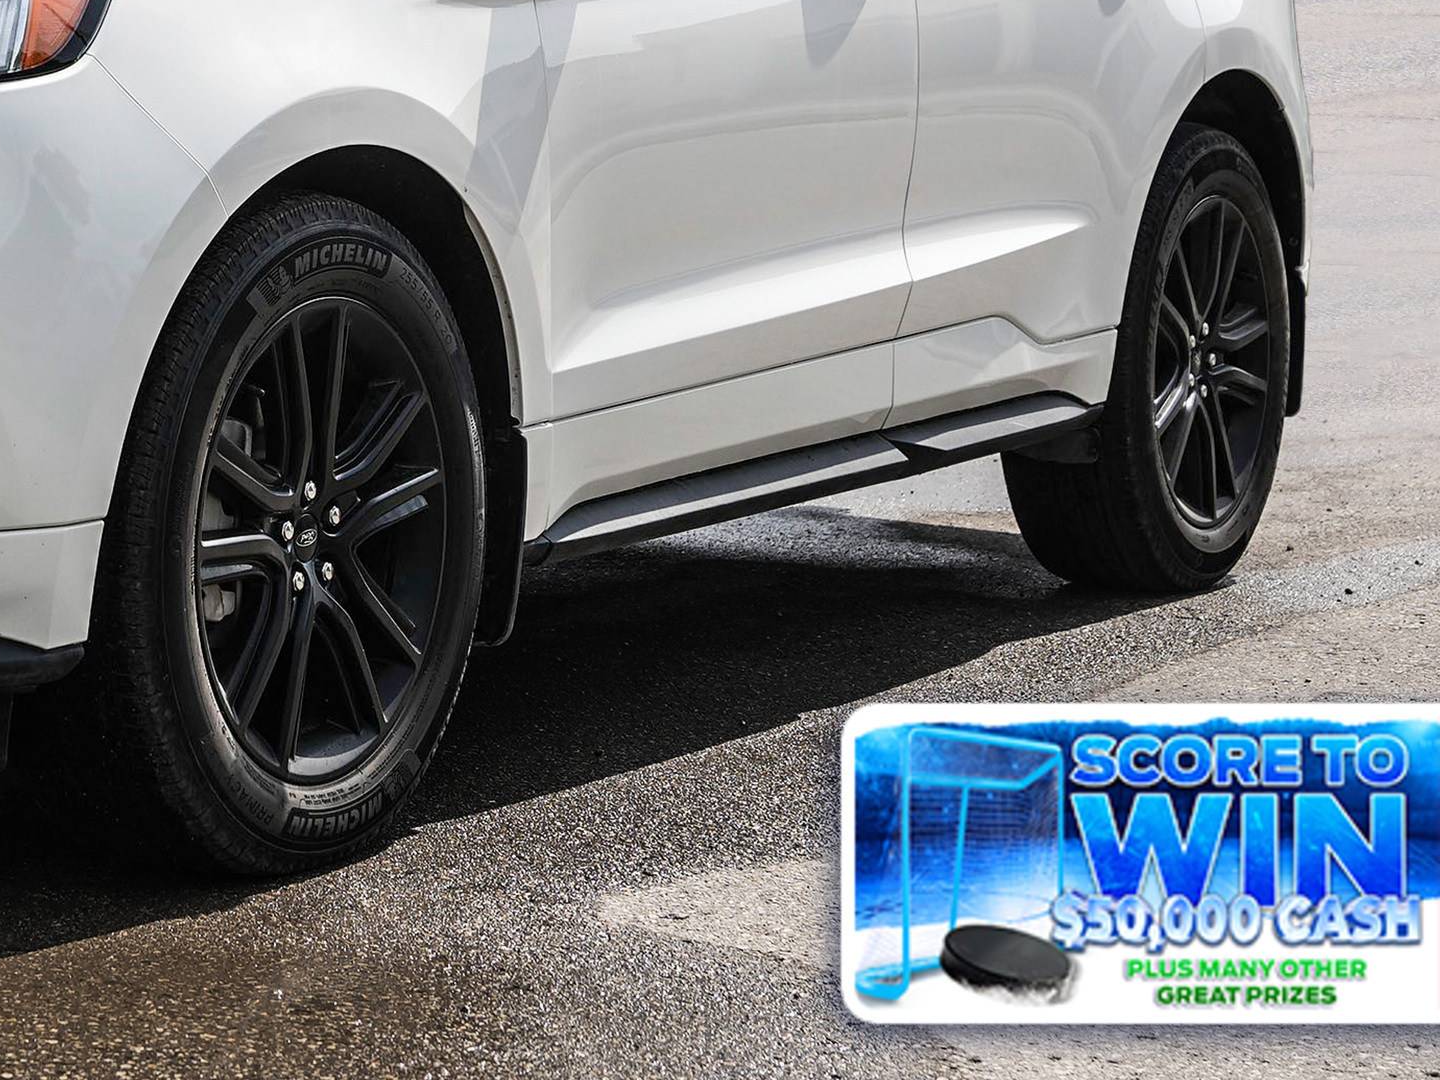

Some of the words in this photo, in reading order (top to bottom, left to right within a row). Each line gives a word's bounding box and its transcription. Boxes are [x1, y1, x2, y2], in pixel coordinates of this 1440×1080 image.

[294, 243, 388, 278] MICHELIN
[399, 267, 435, 310] 255/55
[287, 792, 383, 838] MICHELIN
